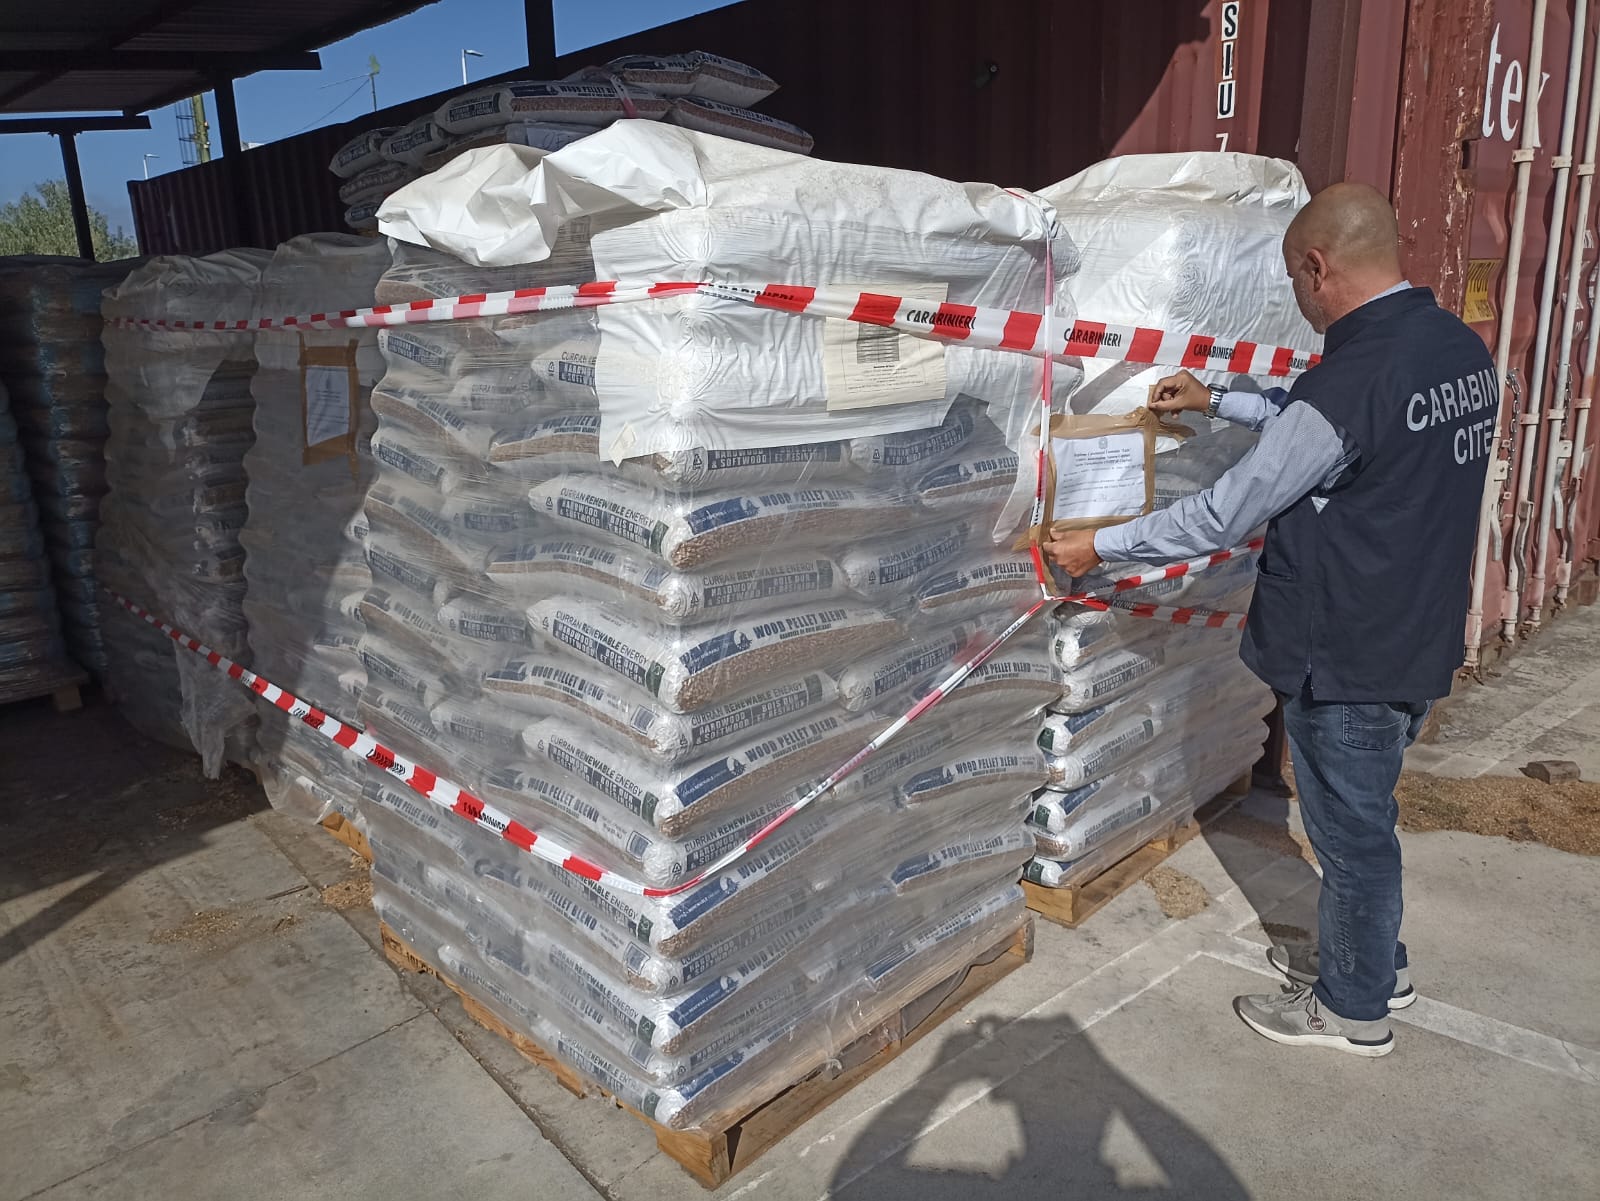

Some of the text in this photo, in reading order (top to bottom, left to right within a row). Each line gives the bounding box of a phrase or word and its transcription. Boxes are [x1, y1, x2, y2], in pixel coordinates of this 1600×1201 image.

[906, 308, 977, 331] CARABINIERI
[1064, 327, 1122, 348] CARABINIERI
[1193, 342, 1237, 361] CARABINIERI
[1453, 416, 1496, 465] CITE
[720, 455, 768, 468] SOFTWOOD
[758, 491, 792, 508] WOOD
[624, 507, 654, 528] ENERGY
[556, 610, 582, 630] CURRAN
[621, 644, 650, 666] ENERGY
[753, 620, 787, 640] WOOD
[786, 613, 819, 631] PELLET
[818, 608, 848, 624] BLEND
[691, 707, 725, 727] CURRAN
[725, 690, 773, 716] RENEWABLE
[744, 716, 839, 763] WOOD PELLET BLEND
[550, 735, 643, 797] CURRAN RENEWABLE ENERGY
[955, 760, 977, 774] WOOD
[977, 756, 1000, 770] PELLET
[548, 784, 575, 808] PELLET
[574, 798, 600, 824] BLEND
[685, 793, 796, 853] CURRAN RENEWABLE ENERGY
[737, 854, 770, 879] WOOD
[769, 835, 800, 861] PELLET
[571, 904, 599, 931] BLEND
[737, 951, 768, 978] WOOD
